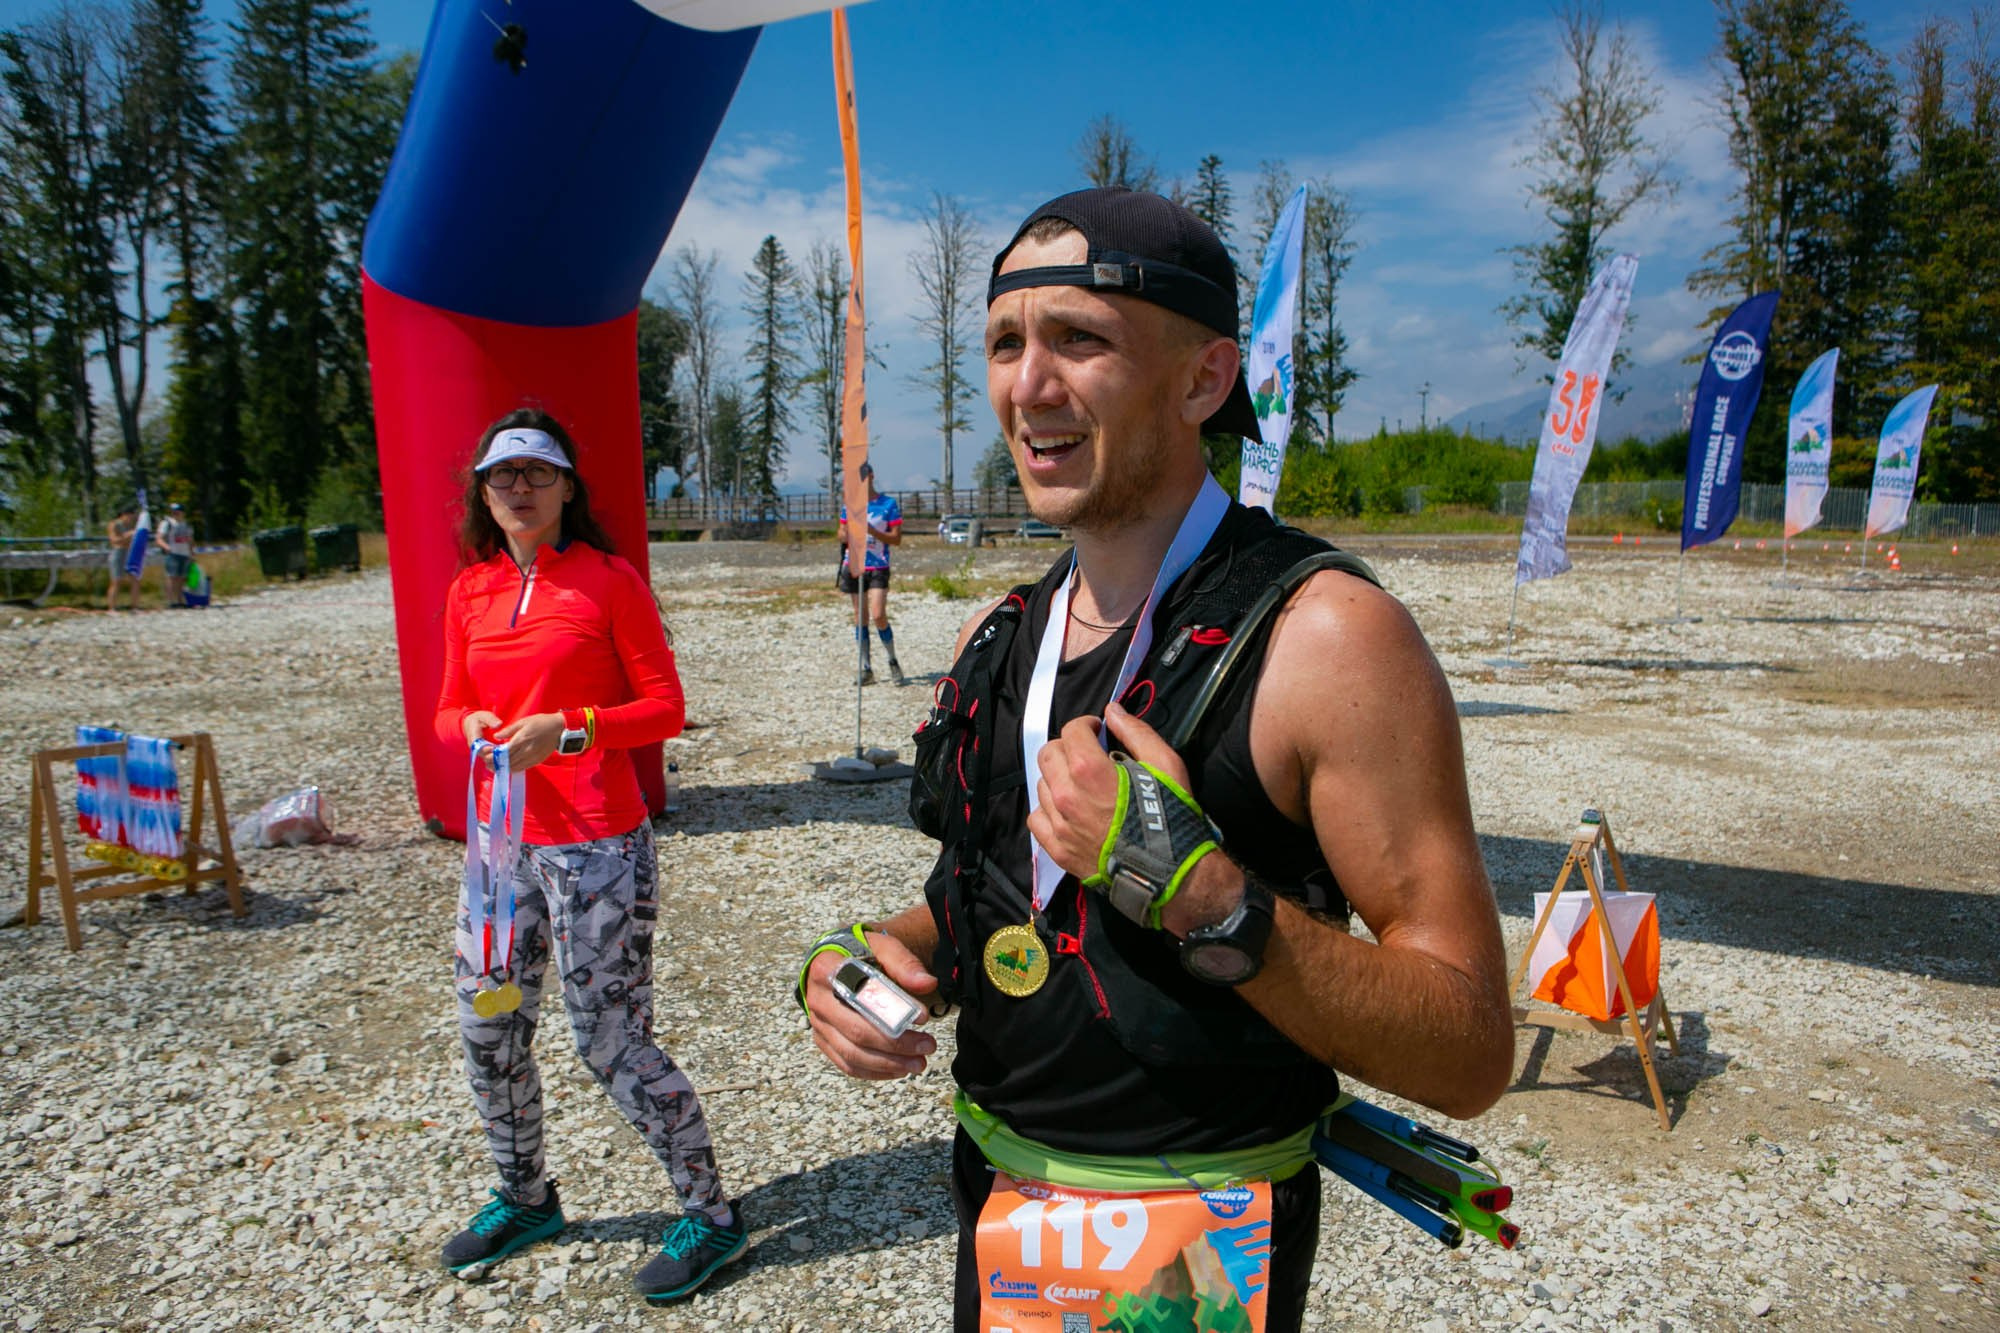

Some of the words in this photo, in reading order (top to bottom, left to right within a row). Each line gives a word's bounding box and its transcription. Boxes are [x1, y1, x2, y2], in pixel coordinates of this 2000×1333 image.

[1694, 434, 1722, 530] PROFESSIONAL
[1711, 395, 1730, 432] RACE
[1715, 433, 1736, 485] COMPANY
[1137, 775, 1163, 830] LEKI
[1007, 1199, 1149, 1271] 119
[1052, 1286, 1100, 1301] КАНТ
